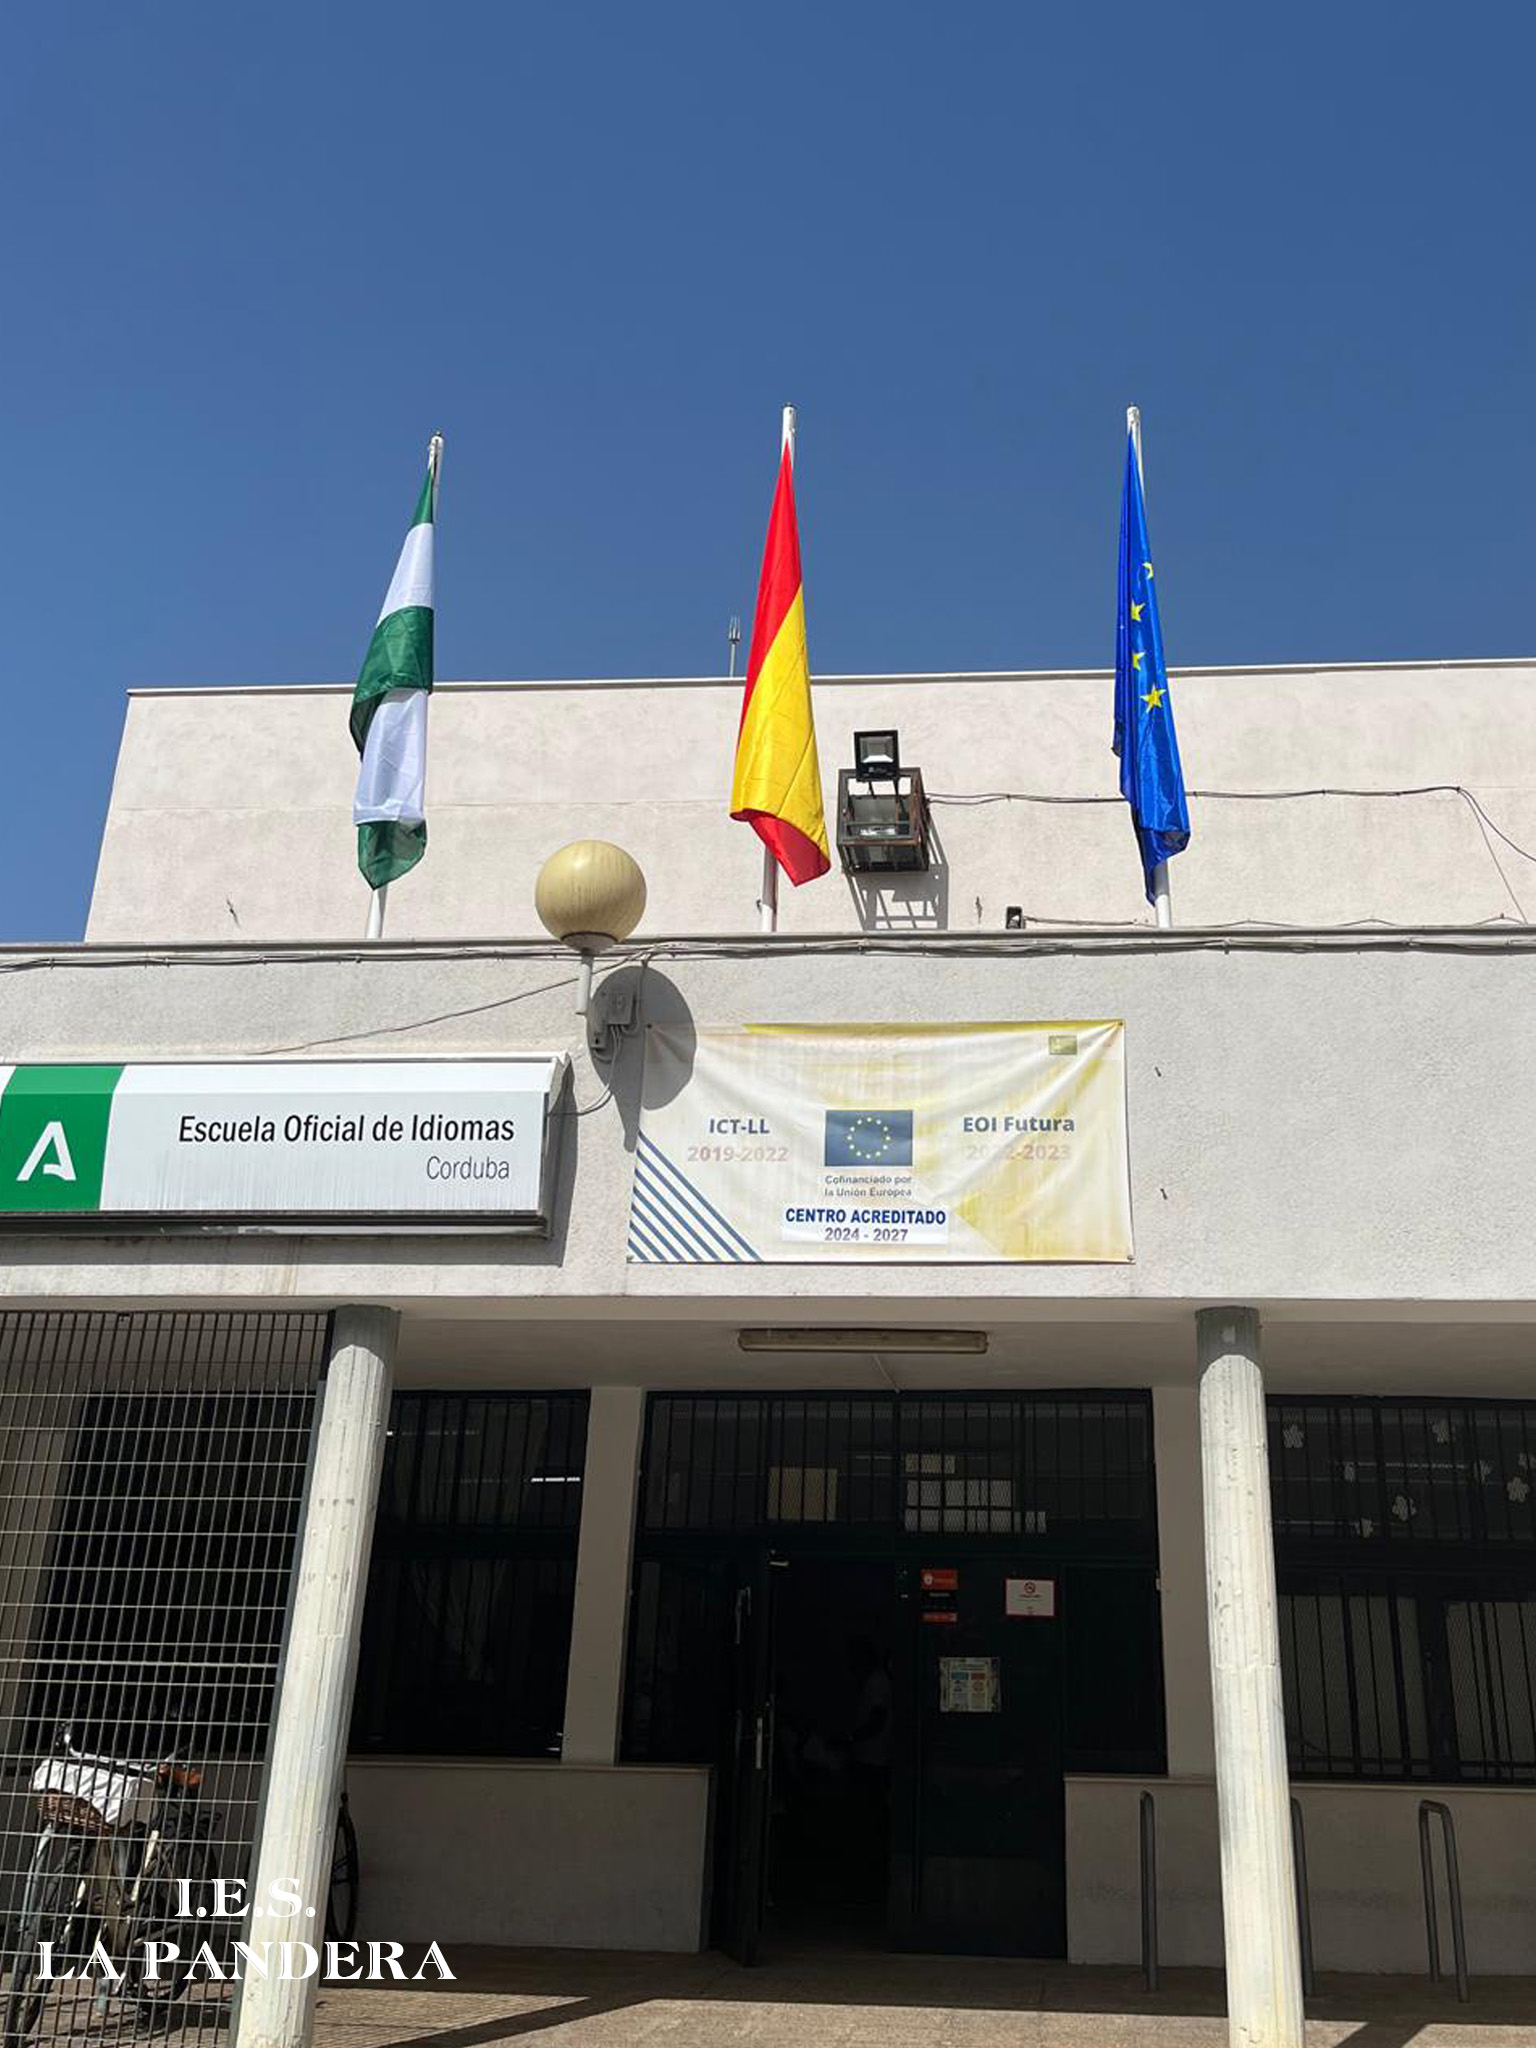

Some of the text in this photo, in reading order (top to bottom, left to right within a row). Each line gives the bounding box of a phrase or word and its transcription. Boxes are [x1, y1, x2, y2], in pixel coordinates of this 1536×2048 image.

[179, 1113, 515, 1143] Escuela Oficial de Idiomas
[708, 1118, 771, 1135] ICT-LL
[963, 1116, 1076, 1133] EOI Futura
[687, 1145, 790, 1163] 2019-2022
[426, 1155, 510, 1180] Corduba
[824, 1174, 912, 1189] Cofinanciado por
[824, 1187, 834, 1198] la
[869, 1187, 912, 1200] Europea
[785, 1207, 946, 1226] CENTRO ACREDITADO
[824, 1226, 860, 1242] 2024
[873, 1227, 909, 1242] 2027
